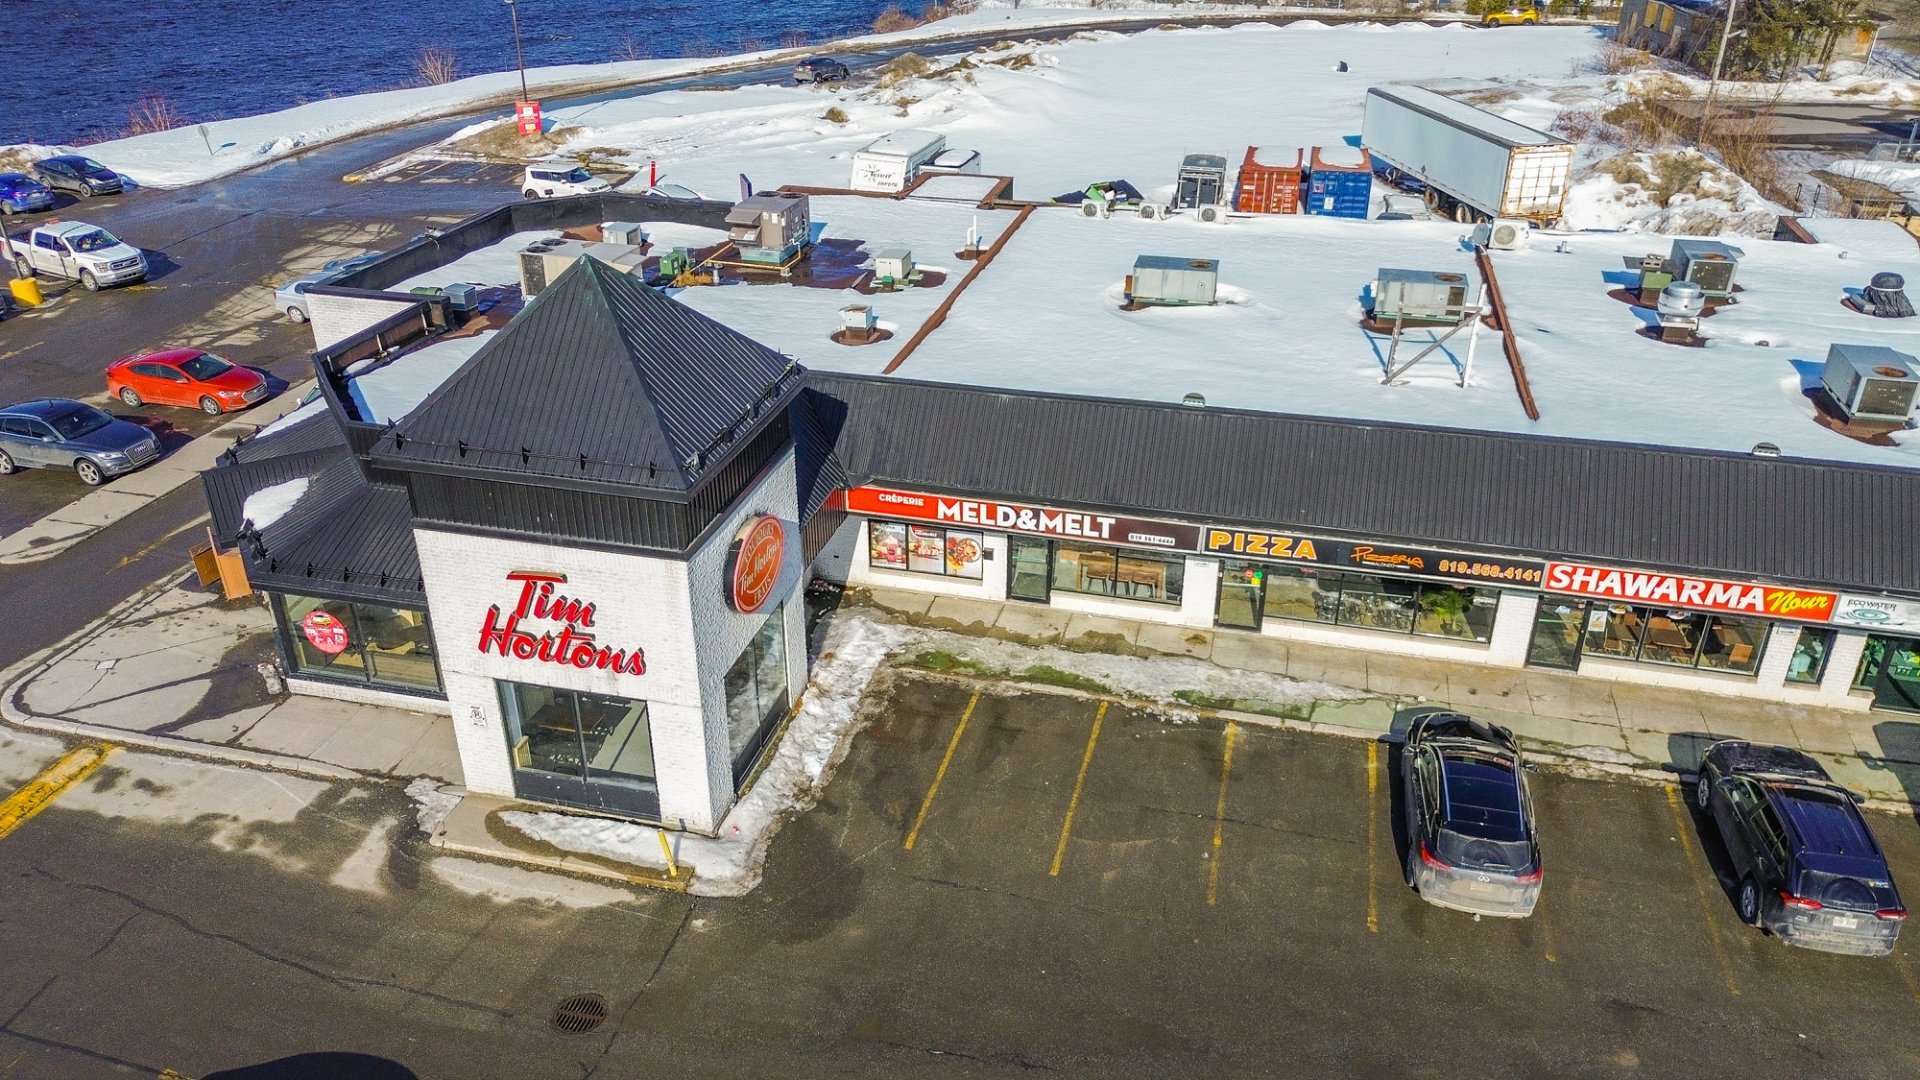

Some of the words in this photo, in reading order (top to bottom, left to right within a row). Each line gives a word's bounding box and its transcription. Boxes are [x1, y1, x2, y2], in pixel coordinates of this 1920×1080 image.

[878, 493, 924, 507] CRÊPERIE
[937, 498, 1116, 539] MELD&MELT
[744, 522, 775, 563] TOUJOURS
[1208, 529, 1318, 560] PIZZA
[741, 573, 754, 595] Tim
[754, 539, 781, 576] Hortons
[1439, 559, 1542, 582] 819.568.4141
[506, 570, 597, 627] Tim
[753, 575, 772, 604] FRAIS
[1548, 564, 1765, 612] SHAWARMA
[1766, 590, 1830, 614] Nour
[478, 603, 647, 676] Hortons
